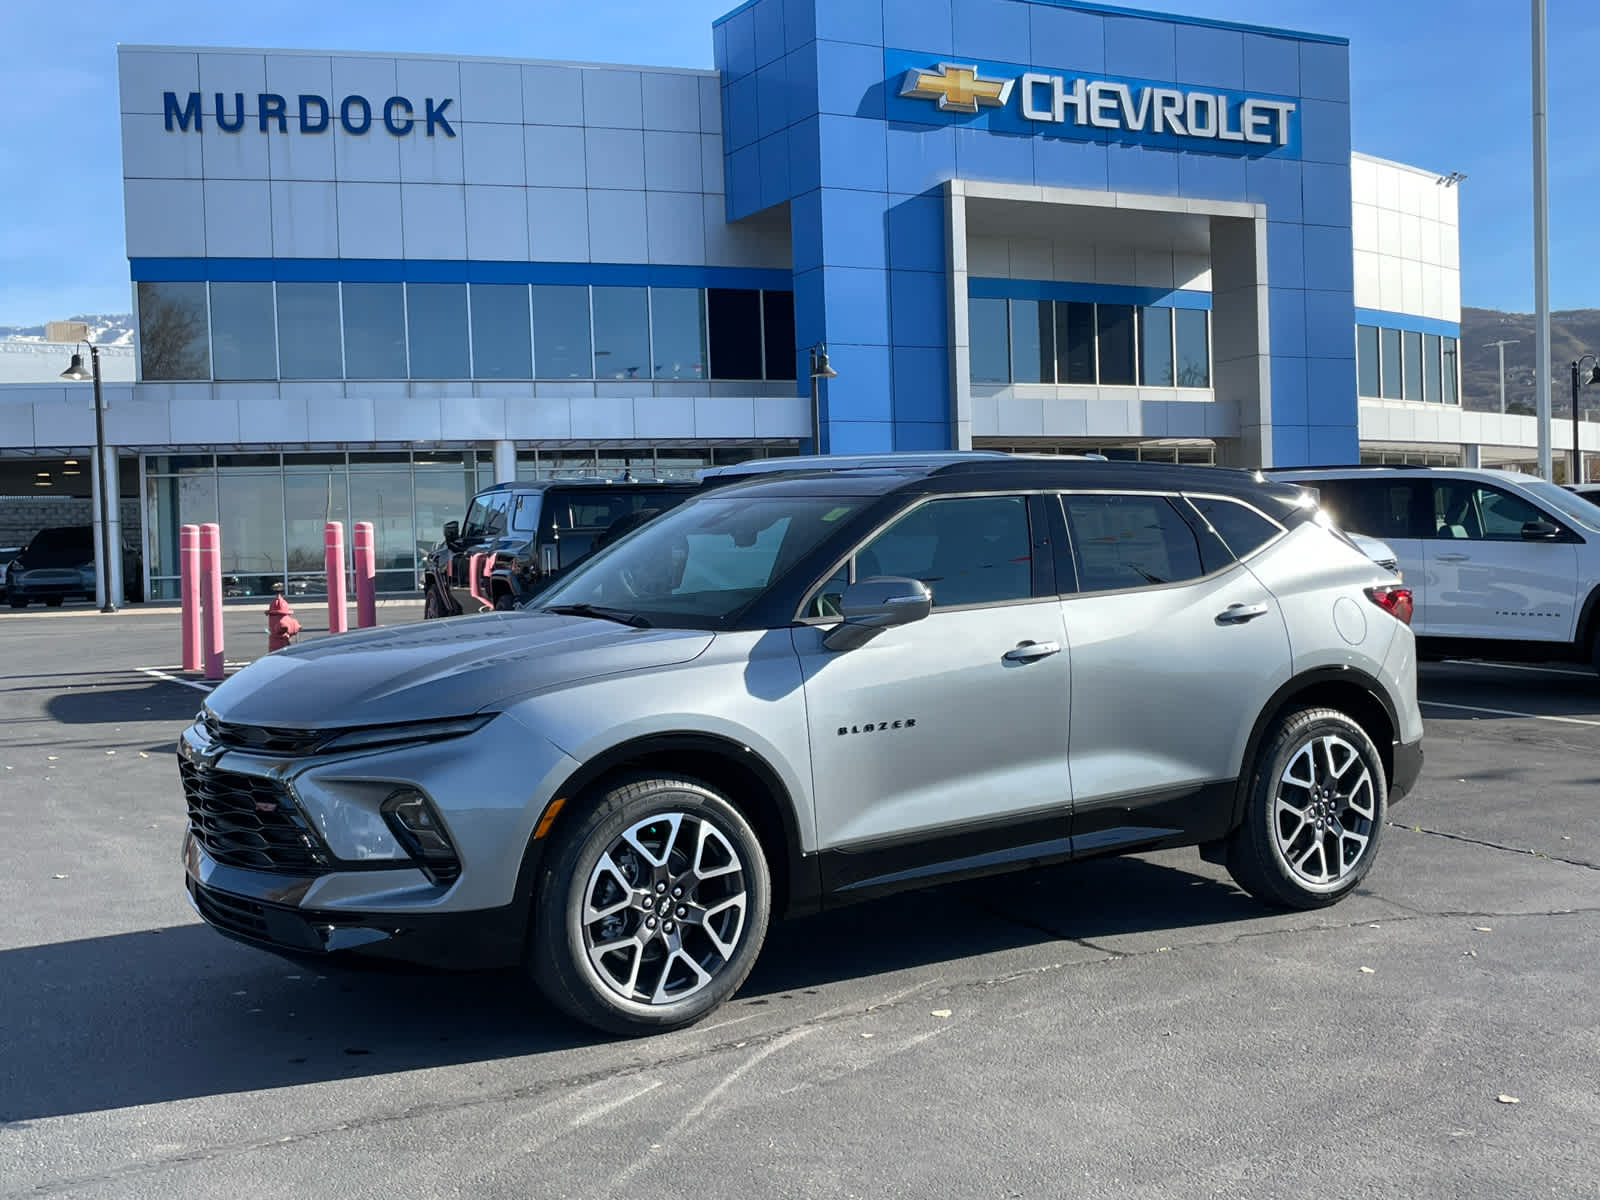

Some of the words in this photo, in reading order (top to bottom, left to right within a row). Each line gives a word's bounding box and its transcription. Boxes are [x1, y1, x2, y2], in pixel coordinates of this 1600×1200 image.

[163, 91, 456, 137] MURDOCK
[1021, 72, 1296, 145] CHEVROLET
[837, 719, 916, 736] BLAZER
